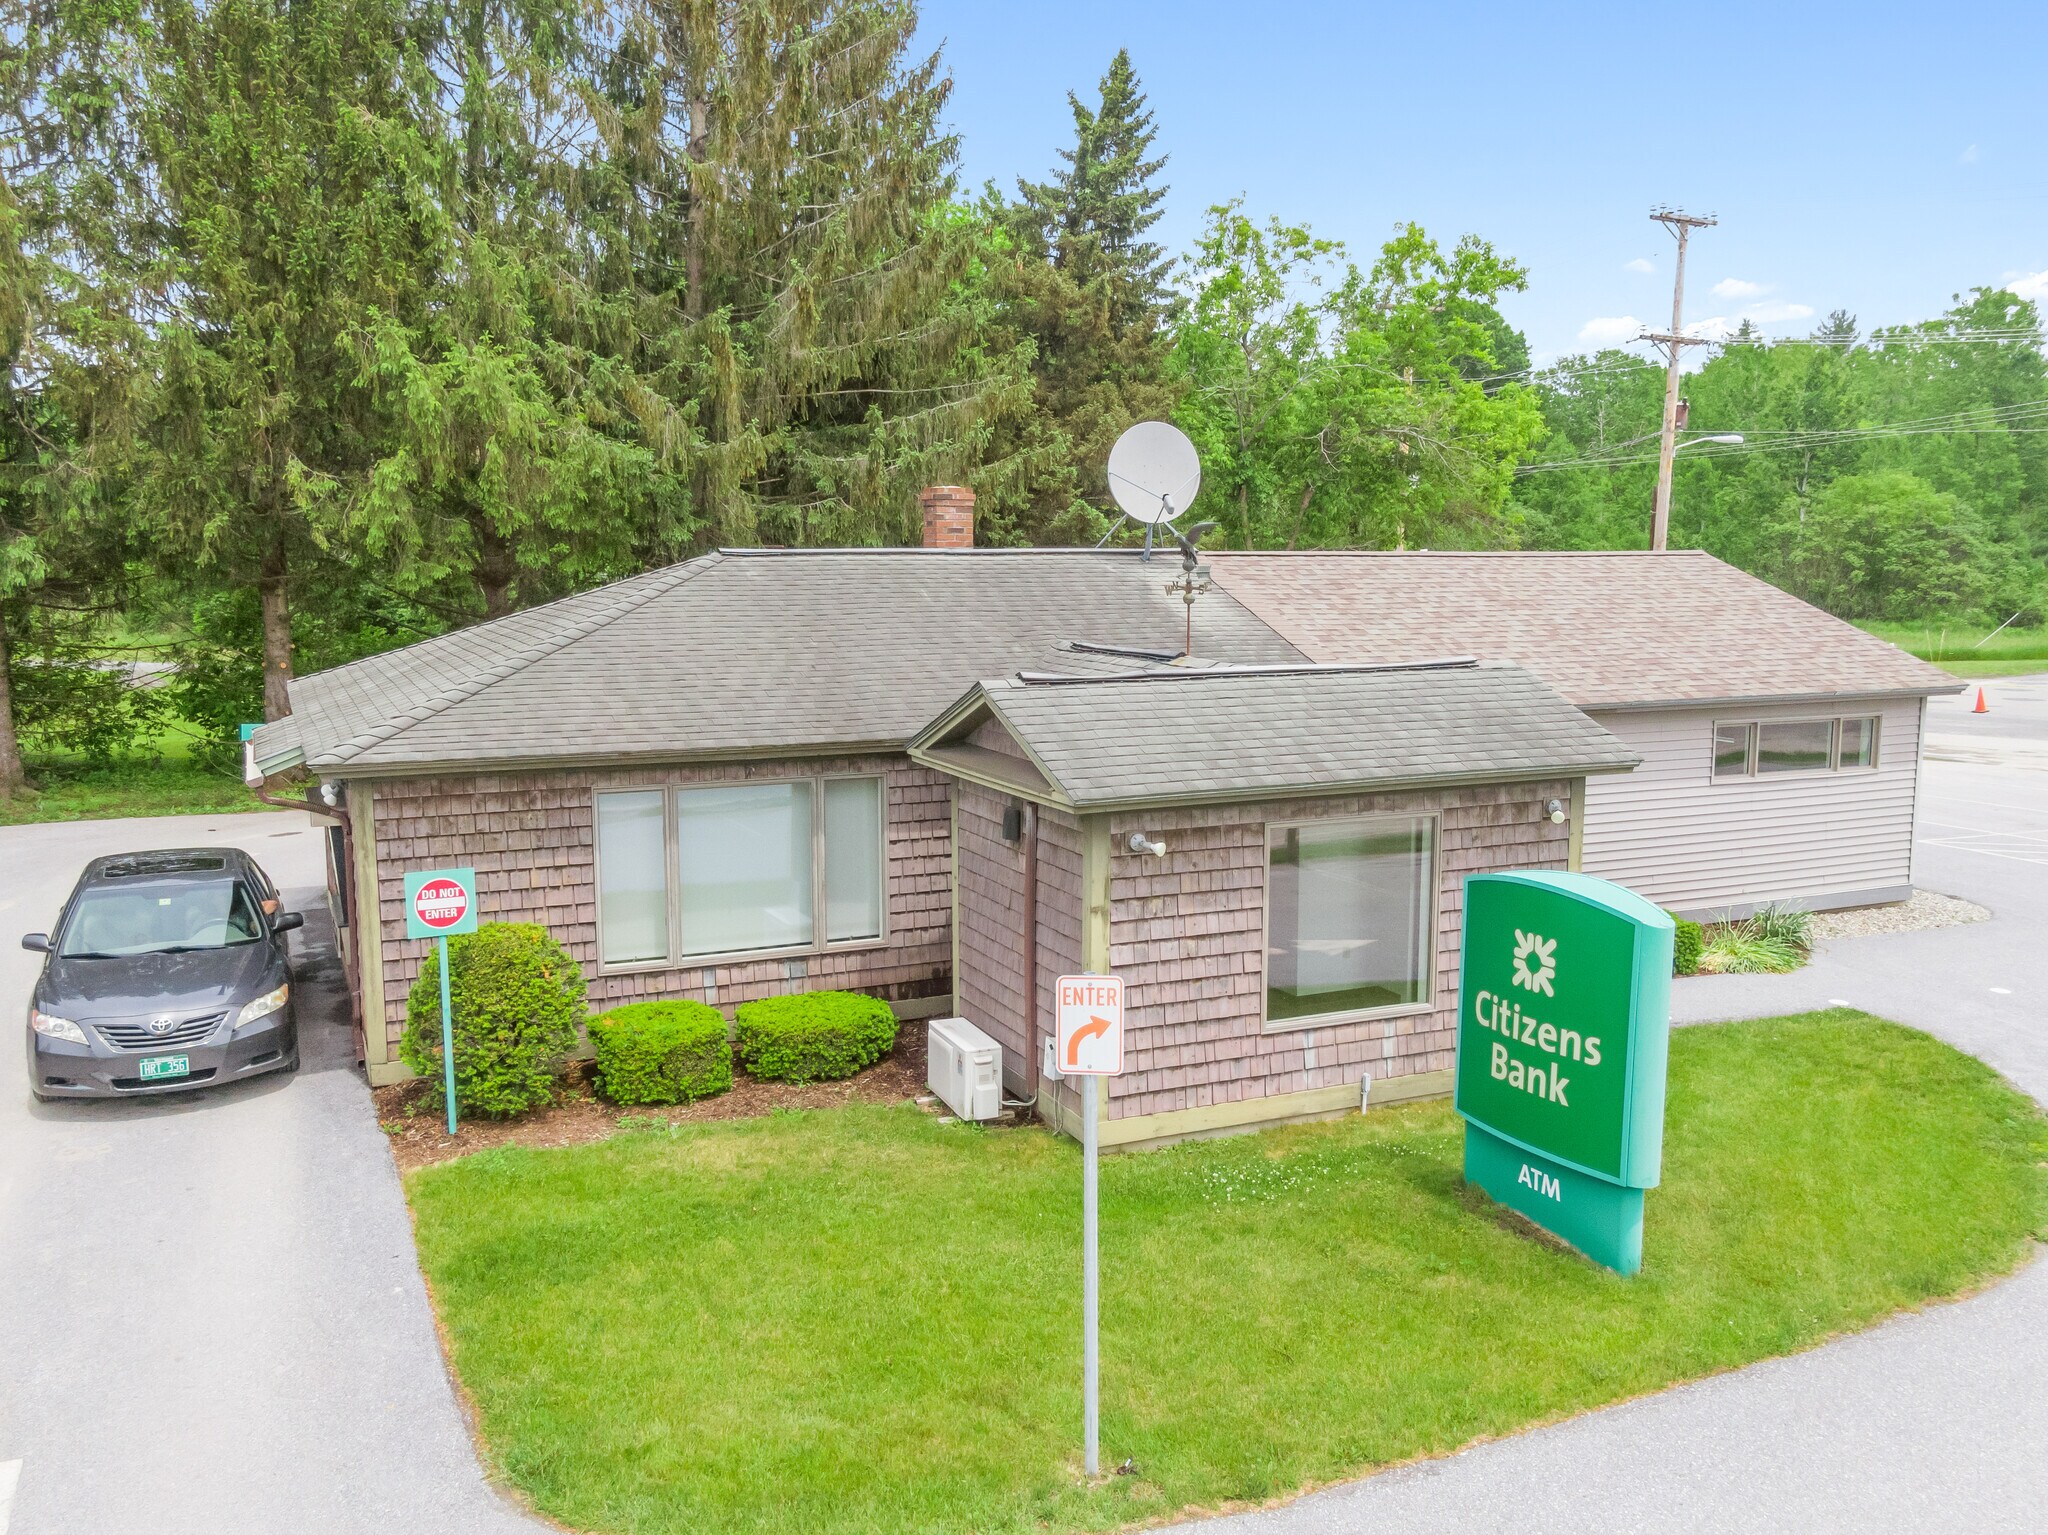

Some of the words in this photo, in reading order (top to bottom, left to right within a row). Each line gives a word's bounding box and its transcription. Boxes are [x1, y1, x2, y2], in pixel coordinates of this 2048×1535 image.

[421, 889, 437, 900] DO
[439, 886, 461, 898] NOT
[425, 907, 458, 920] ENTER
[1062, 986, 1117, 1006] ENTER
[1475, 990, 1602, 1066] Citizens
[167, 1060, 185, 1072] 356
[1490, 1041, 1570, 1107] Bank
[1517, 1163, 1561, 1203] ATM
